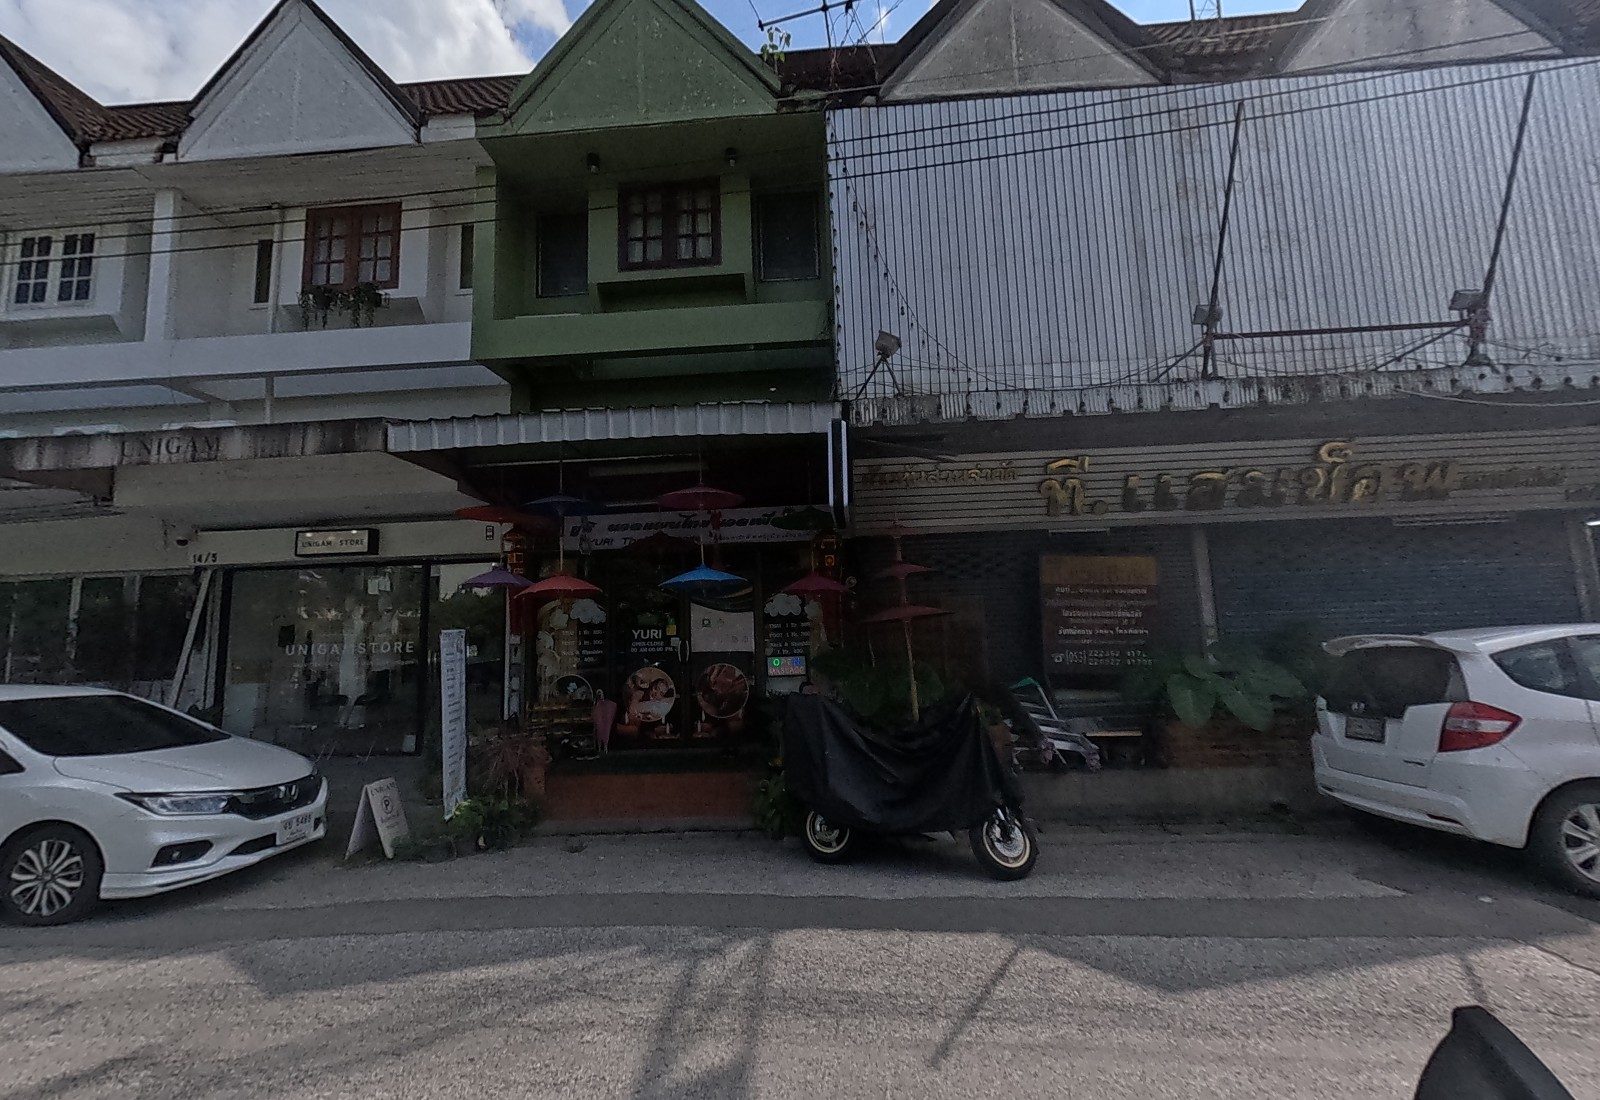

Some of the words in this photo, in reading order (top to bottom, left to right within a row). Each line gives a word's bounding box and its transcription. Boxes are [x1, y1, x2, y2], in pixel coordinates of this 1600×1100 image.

[302, 539, 332, 549] UNIGAM
[339, 537, 365, 547] STORE
[632, 629, 662, 640] YURI
[358, 641, 415, 655] STORE
